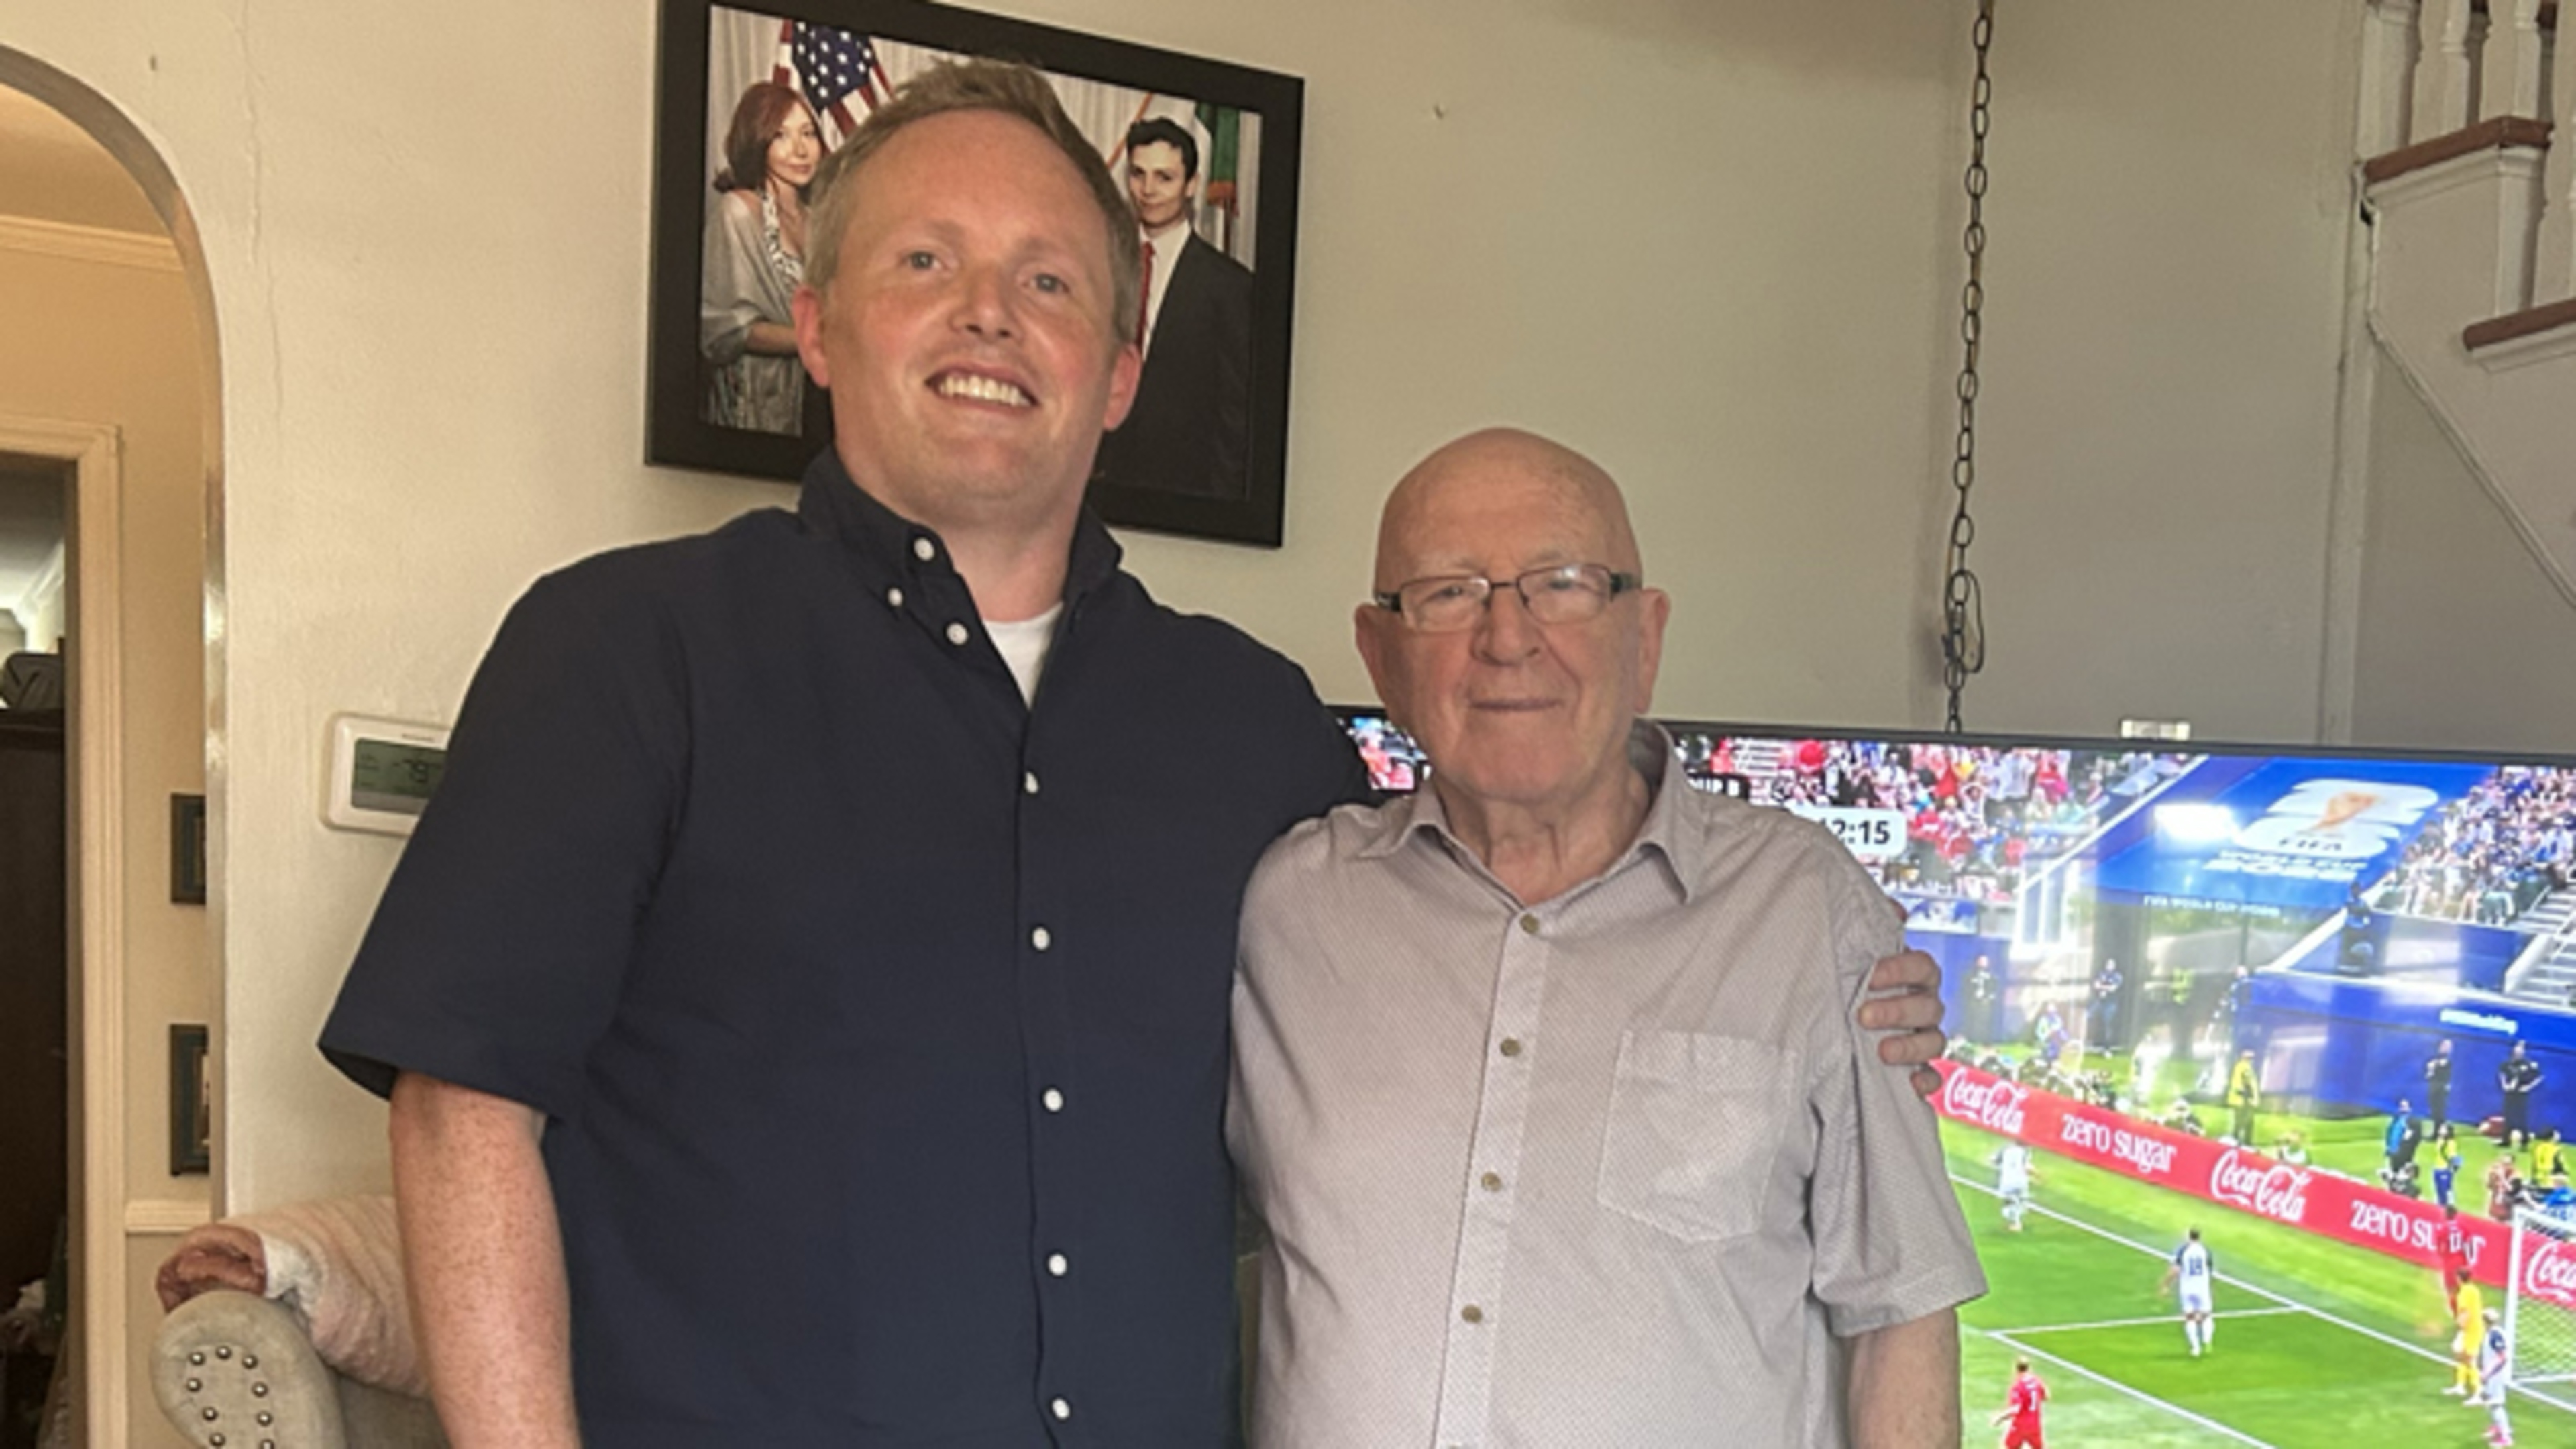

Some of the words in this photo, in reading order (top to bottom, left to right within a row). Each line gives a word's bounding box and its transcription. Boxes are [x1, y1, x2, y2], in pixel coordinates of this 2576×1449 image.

[2061, 1113, 2110, 1152] zero
[2113, 1130, 2177, 1173] sugar
[2350, 1199, 2409, 1242] zero
